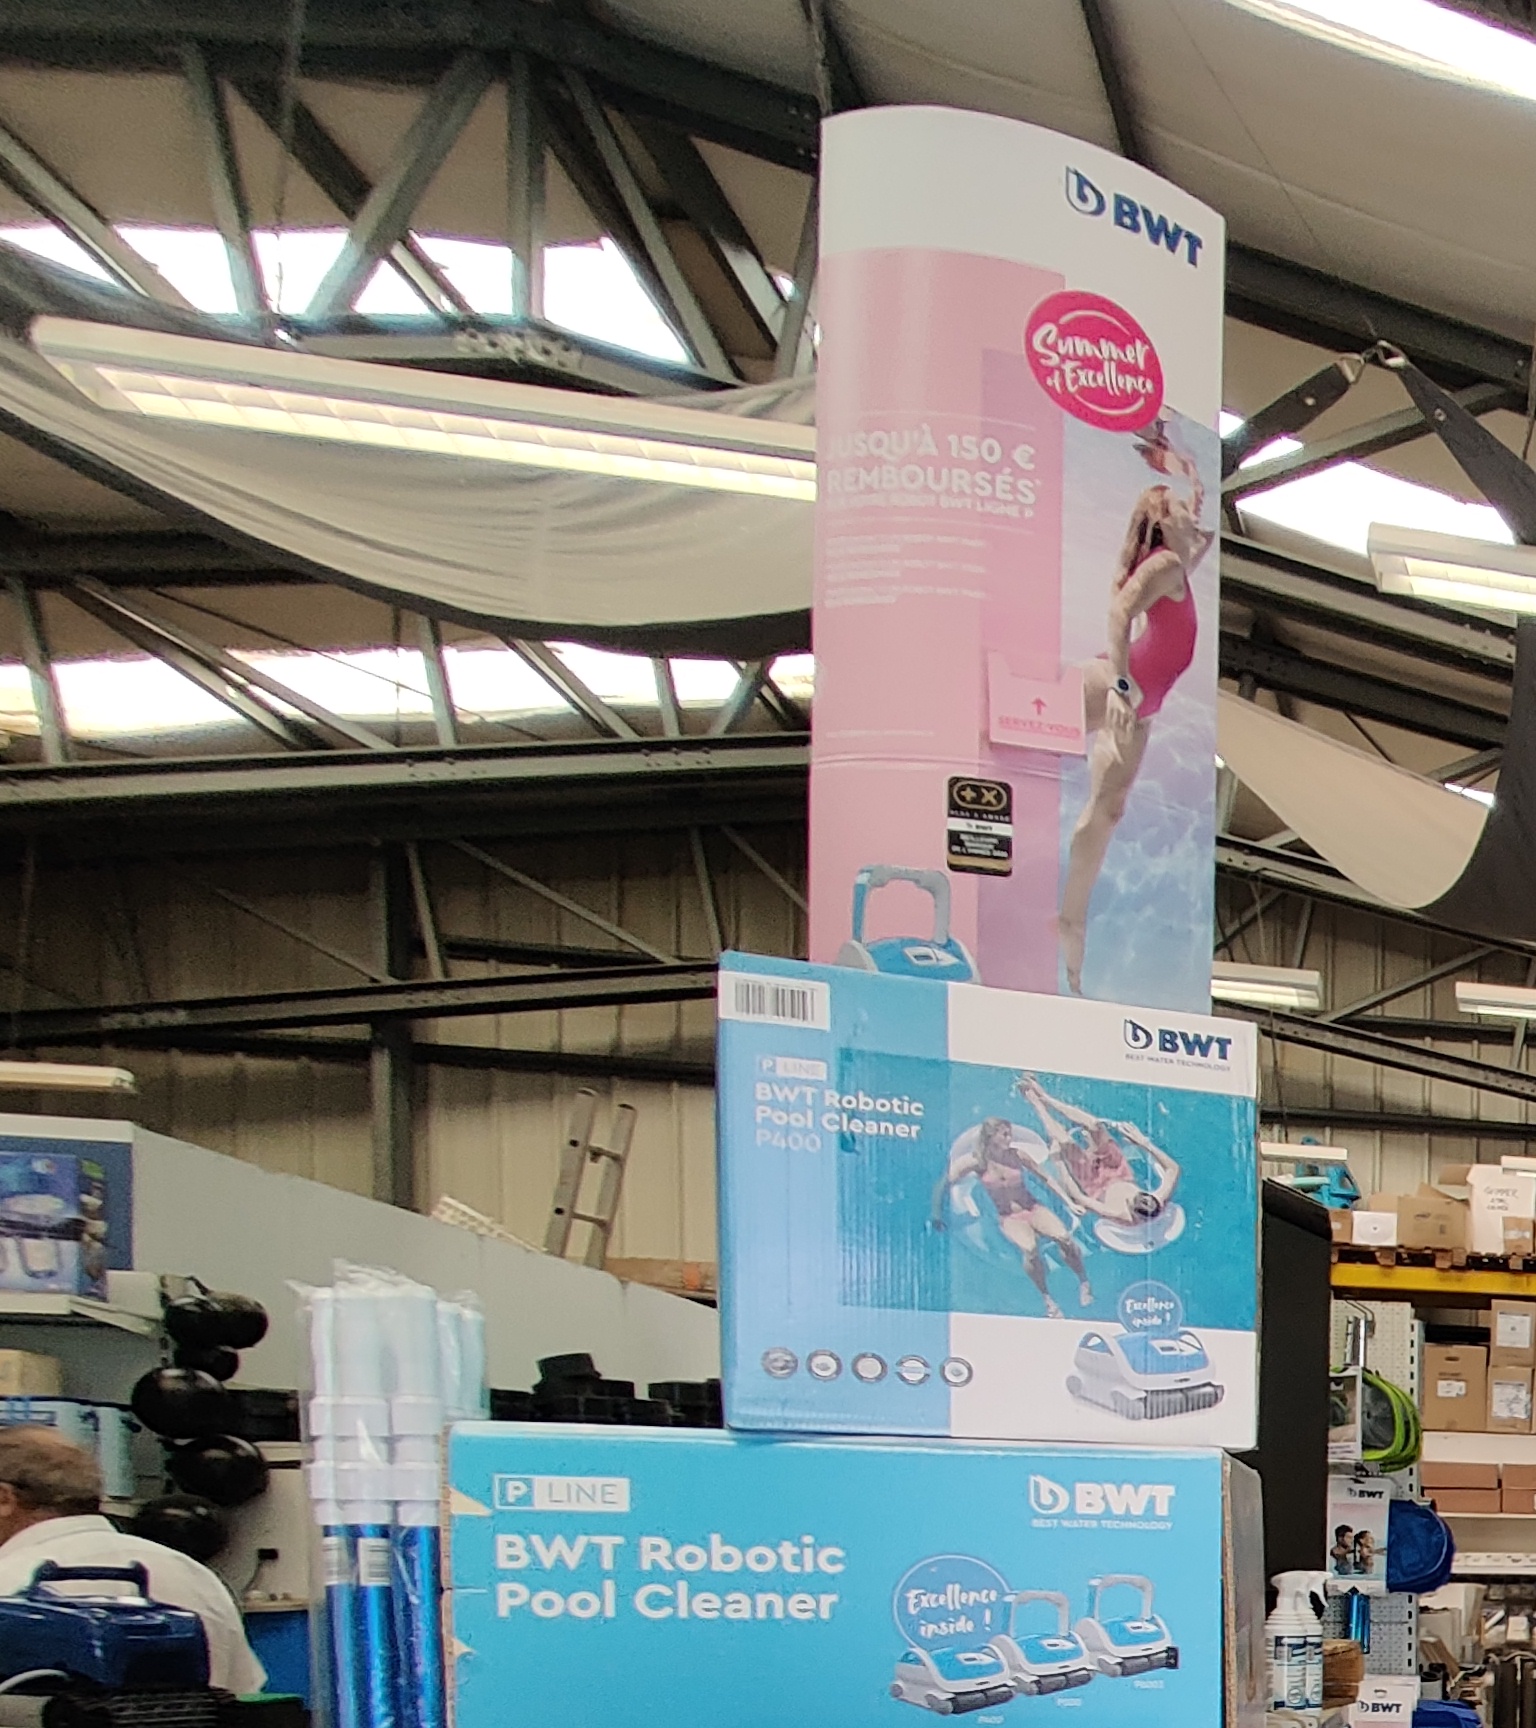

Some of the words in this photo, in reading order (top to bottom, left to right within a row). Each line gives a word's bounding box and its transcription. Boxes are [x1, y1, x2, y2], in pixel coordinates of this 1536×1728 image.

[1113, 192, 1203, 268] BWT
[1032, 322, 1149, 371] Summer
[1062, 360, 1154, 397] Excellence
[828, 423, 939, 461] JUSQU'À
[948, 434, 1002, 464] 150
[1012, 443, 1036, 471] €
[1158, 1028, 1232, 1061] BWT
[755, 1081, 818, 1107] BWT
[823, 1088, 925, 1117] Robotic
[755, 1104, 814, 1130] Pool
[821, 1111, 922, 1141] Cleaner
[755, 1128, 822, 1153] P400
[506, 1480, 528, 1503] P
[548, 1483, 619, 1505] LINE
[1074, 1482, 1176, 1517] BWT
[1358, 1490, 1384, 1500] BWT
[1031, 1518, 1058, 1529] BEST
[1061, 1519, 1097, 1530] WATER
[1100, 1519, 1173, 1531] TECHNOLOGY
[495, 1533, 626, 1571] BWT
[639, 1531, 846, 1574] Robotic
[496, 1578, 617, 1619] Pool
[634, 1579, 840, 1620] Cleaner
[906, 1583, 998, 1615] Excellence
[919, 1615, 975, 1639] inside
[1371, 1702, 1402, 1714] BWT
